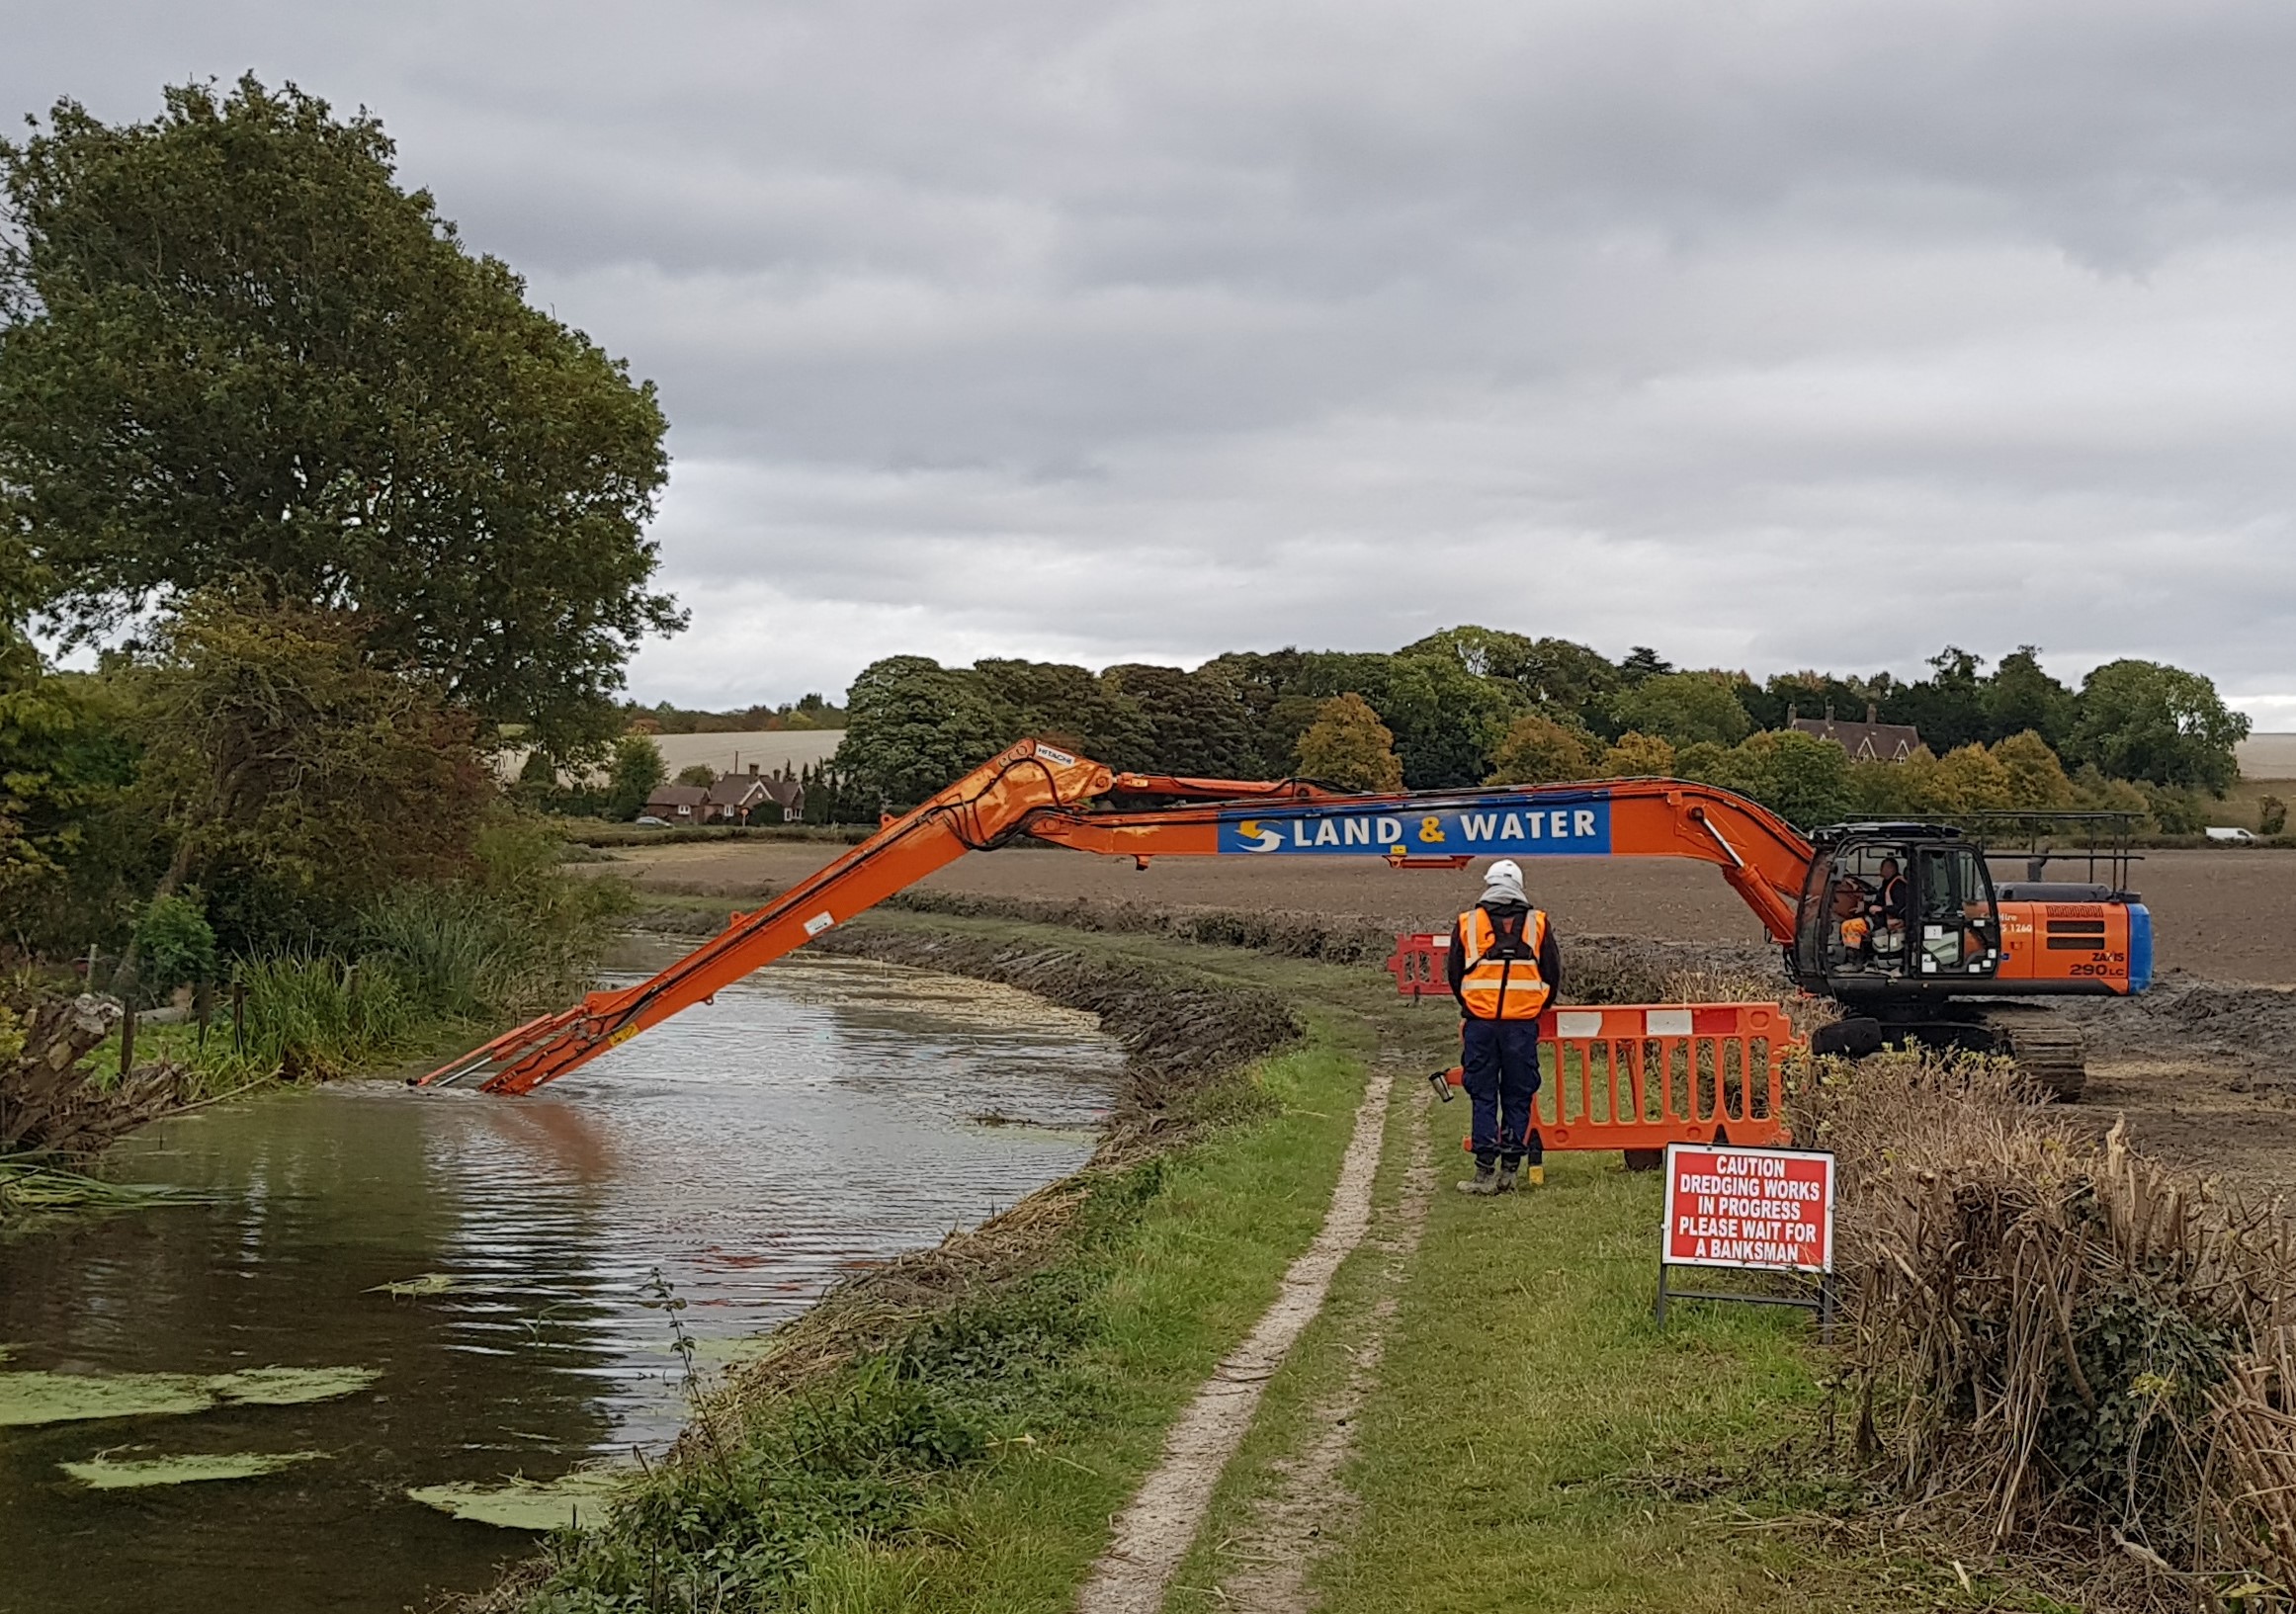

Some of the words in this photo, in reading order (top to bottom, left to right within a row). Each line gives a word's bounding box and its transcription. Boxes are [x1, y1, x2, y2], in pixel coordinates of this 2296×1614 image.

[1294, 816, 1403, 847] LAND
[1419, 815, 1446, 843] &
[1460, 809, 1596, 841] WATER
[2010, 924, 2033, 933] 1260
[1716, 1154, 1785, 1178] CAUTION
[1680, 1173, 1759, 1197] DREDGING
[1764, 1179, 1821, 1202] WORKS
[1698, 1195, 1715, 1216] IN
[1719, 1197, 1801, 1221] PROGRESS
[1678, 1216, 1739, 1238] PLEASE
[1742, 1220, 1782, 1240] WAIT
[1785, 1223, 1817, 1243] FOR
[1694, 1237, 1707, 1258] A
[1711, 1239, 1799, 1262] BANKSMAN
